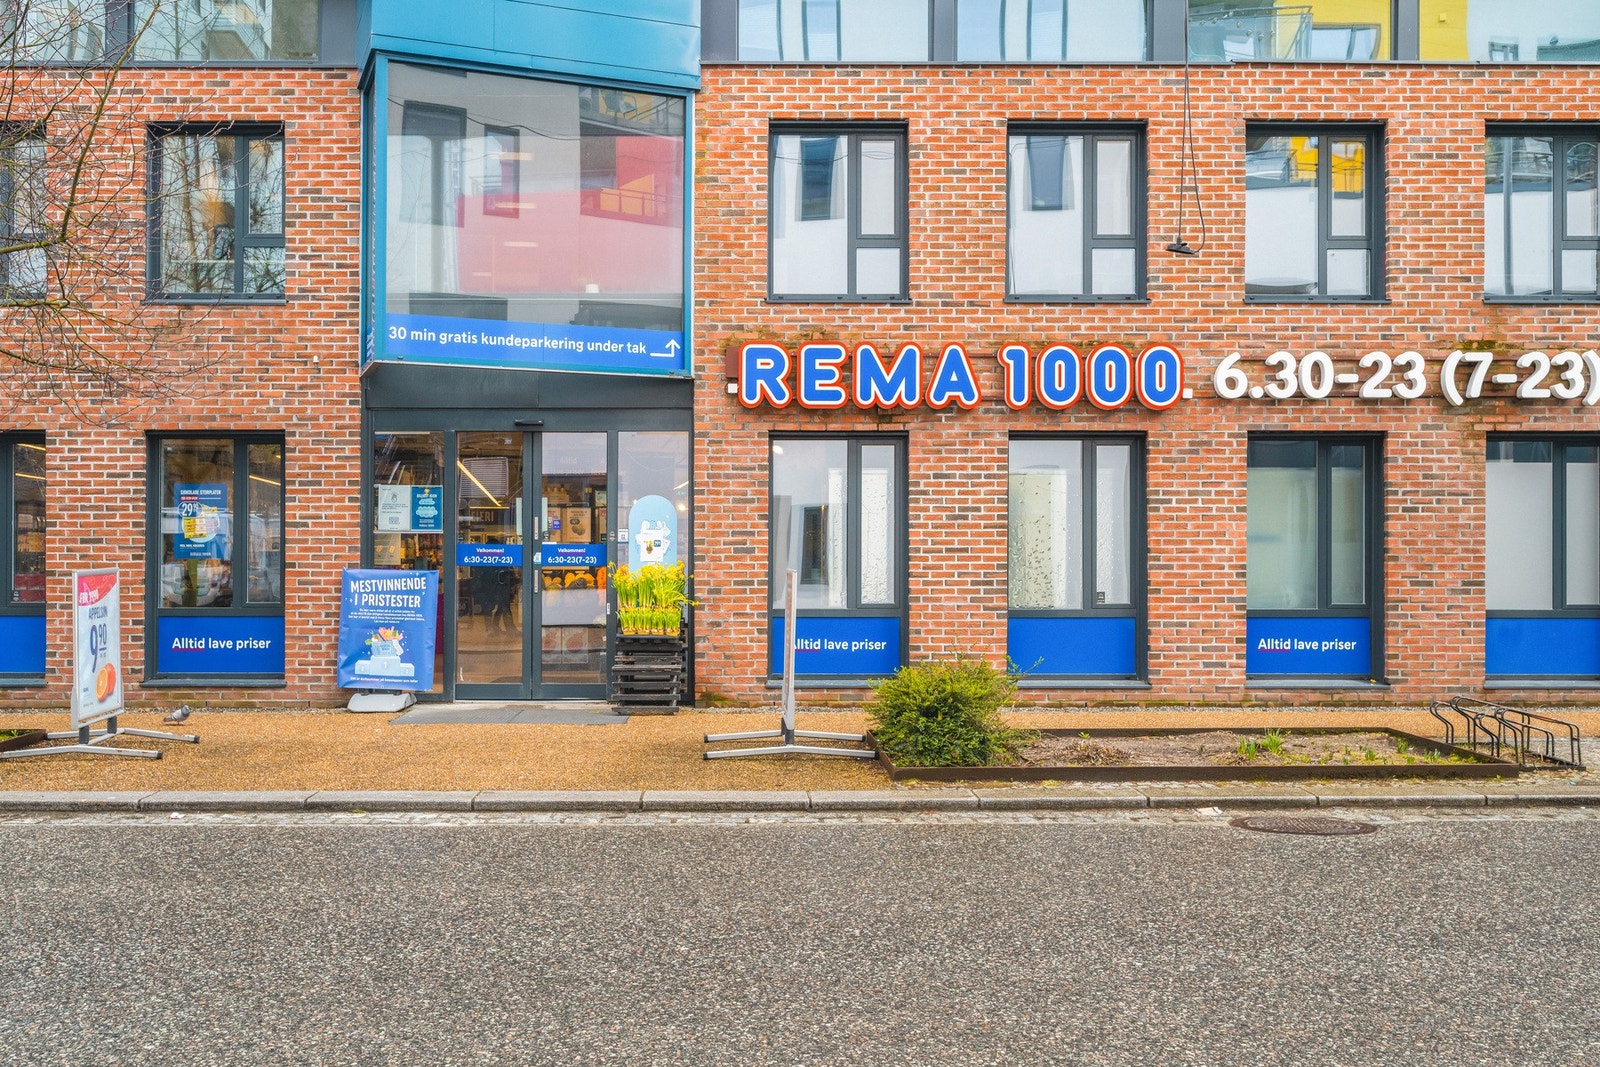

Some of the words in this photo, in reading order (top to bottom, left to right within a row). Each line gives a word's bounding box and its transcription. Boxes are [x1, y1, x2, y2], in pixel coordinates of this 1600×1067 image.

[388, 326, 407, 340] 30
[410, 328, 436, 342] min
[439, 330, 478, 345] gratis
[481, 329, 584, 352] kundeparkering
[587, 339, 624, 353] under
[626, 342, 647, 354] tak
[738, 340, 982, 409] REMA
[997, 341, 1185, 411] 1000
[1213, 351, 1427, 399] 6.30-23
[1440, 349, 1600, 406] (7-23)
[181, 503, 193, 517] 29
[463, 555, 513, 564] 6:30-23(7-23)
[547, 555, 597, 564] 6:30-23(7-23)
[350, 577, 427, 594] MESTVINNENDE
[354, 593, 358, 606] I
[361, 594, 421, 608] PRISTESTER
[88, 605, 108, 619] APPELSIN
[172, 637, 205, 649] Alltid
[208, 637, 233, 649] lave
[236, 637, 271, 651] priser
[794, 638, 821, 650] lltid
[824, 638, 849, 650] lave
[851, 638, 887, 652] priser
[1258, 638, 1291, 650] Alltid
[1294, 638, 1318, 650] lave
[1321, 638, 1357, 652] priser
